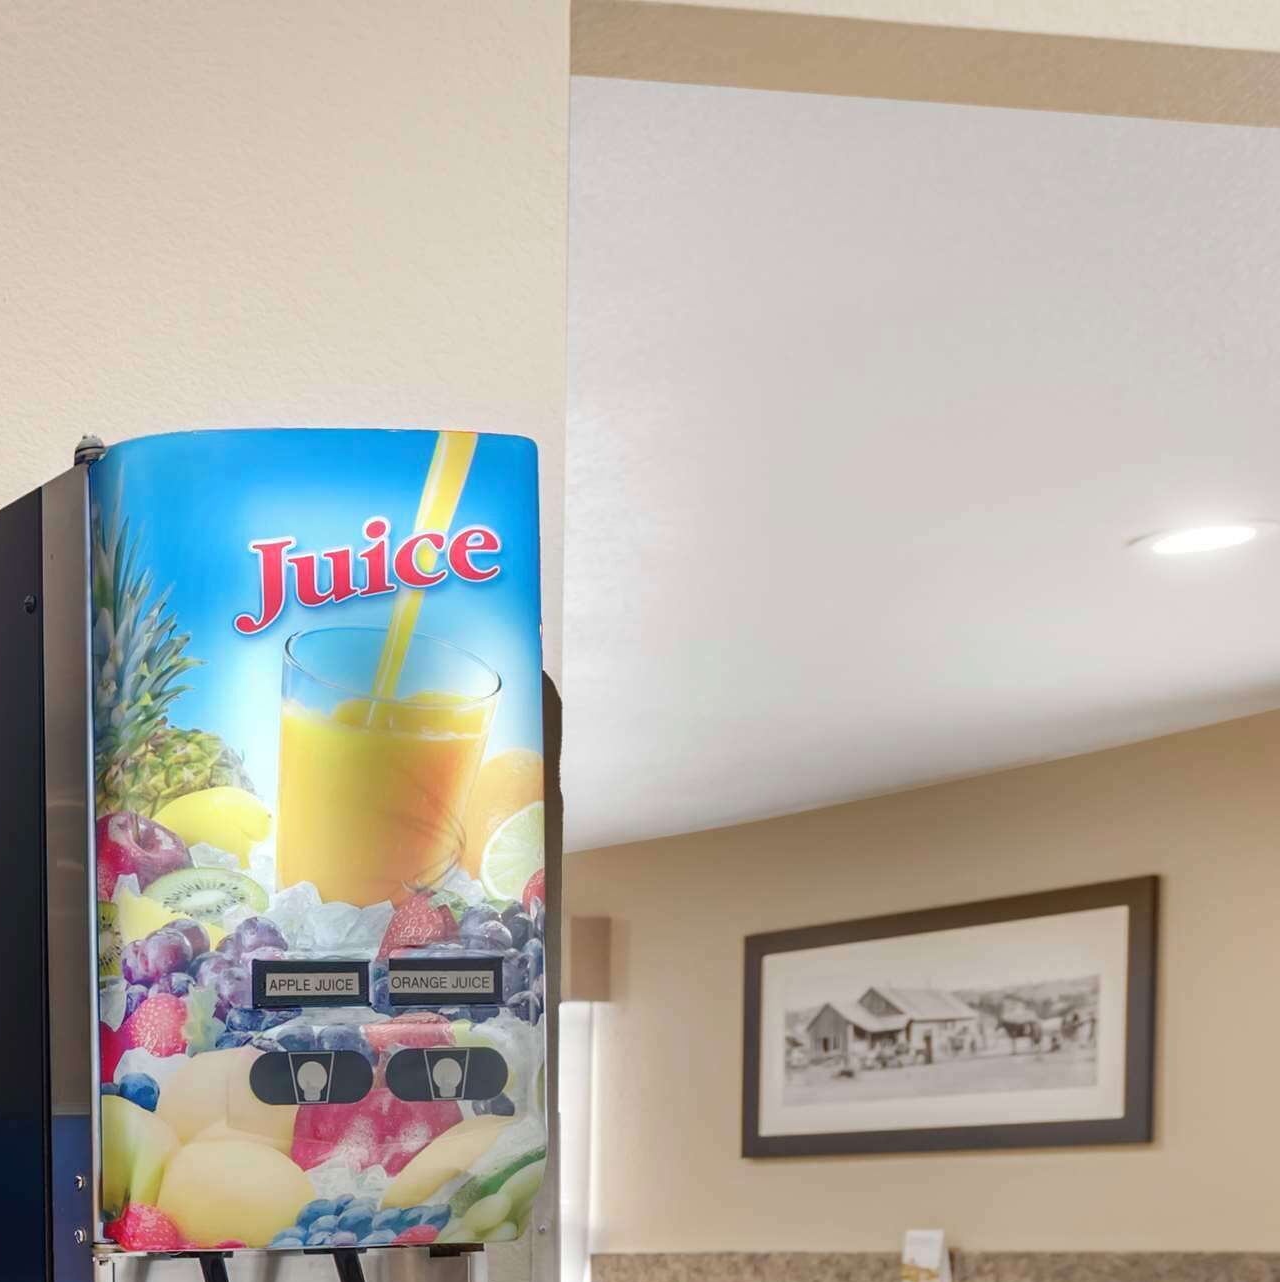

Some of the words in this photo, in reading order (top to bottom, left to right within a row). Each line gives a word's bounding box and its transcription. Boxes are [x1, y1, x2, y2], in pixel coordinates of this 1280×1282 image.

[234, 516, 503, 635] Juice
[269, 979, 311, 991] APPLE
[315, 978, 354, 992] JUICE
[391, 976, 447, 990] ORANGE
[451, 976, 490, 989] JUICE
